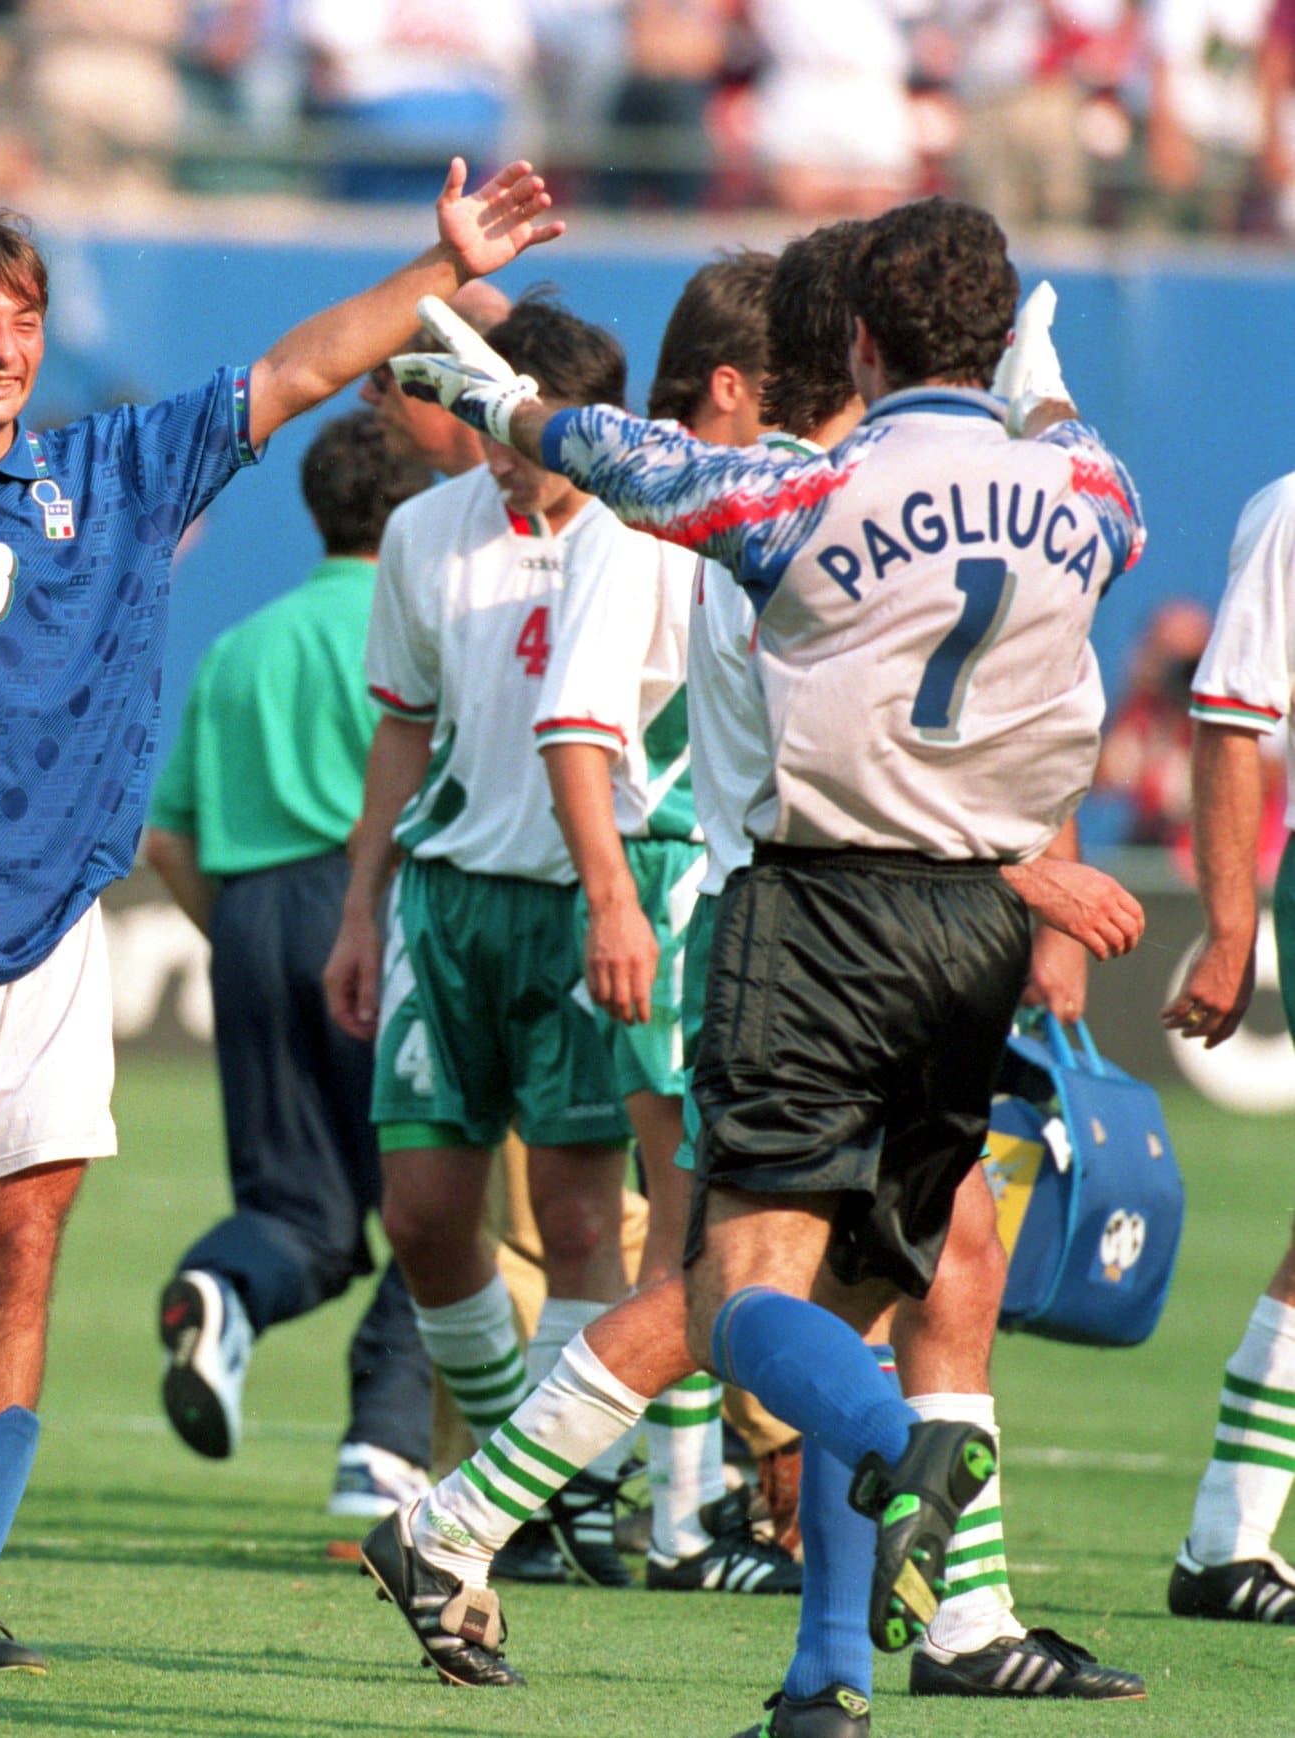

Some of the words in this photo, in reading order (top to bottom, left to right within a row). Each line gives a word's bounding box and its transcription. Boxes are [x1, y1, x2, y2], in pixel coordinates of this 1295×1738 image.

[816, 481, 1099, 601] PAGLIUCA
[514, 604, 551, 678] 4
[911, 556, 1017, 744] 1
[394, 1019, 434, 1094] 4
